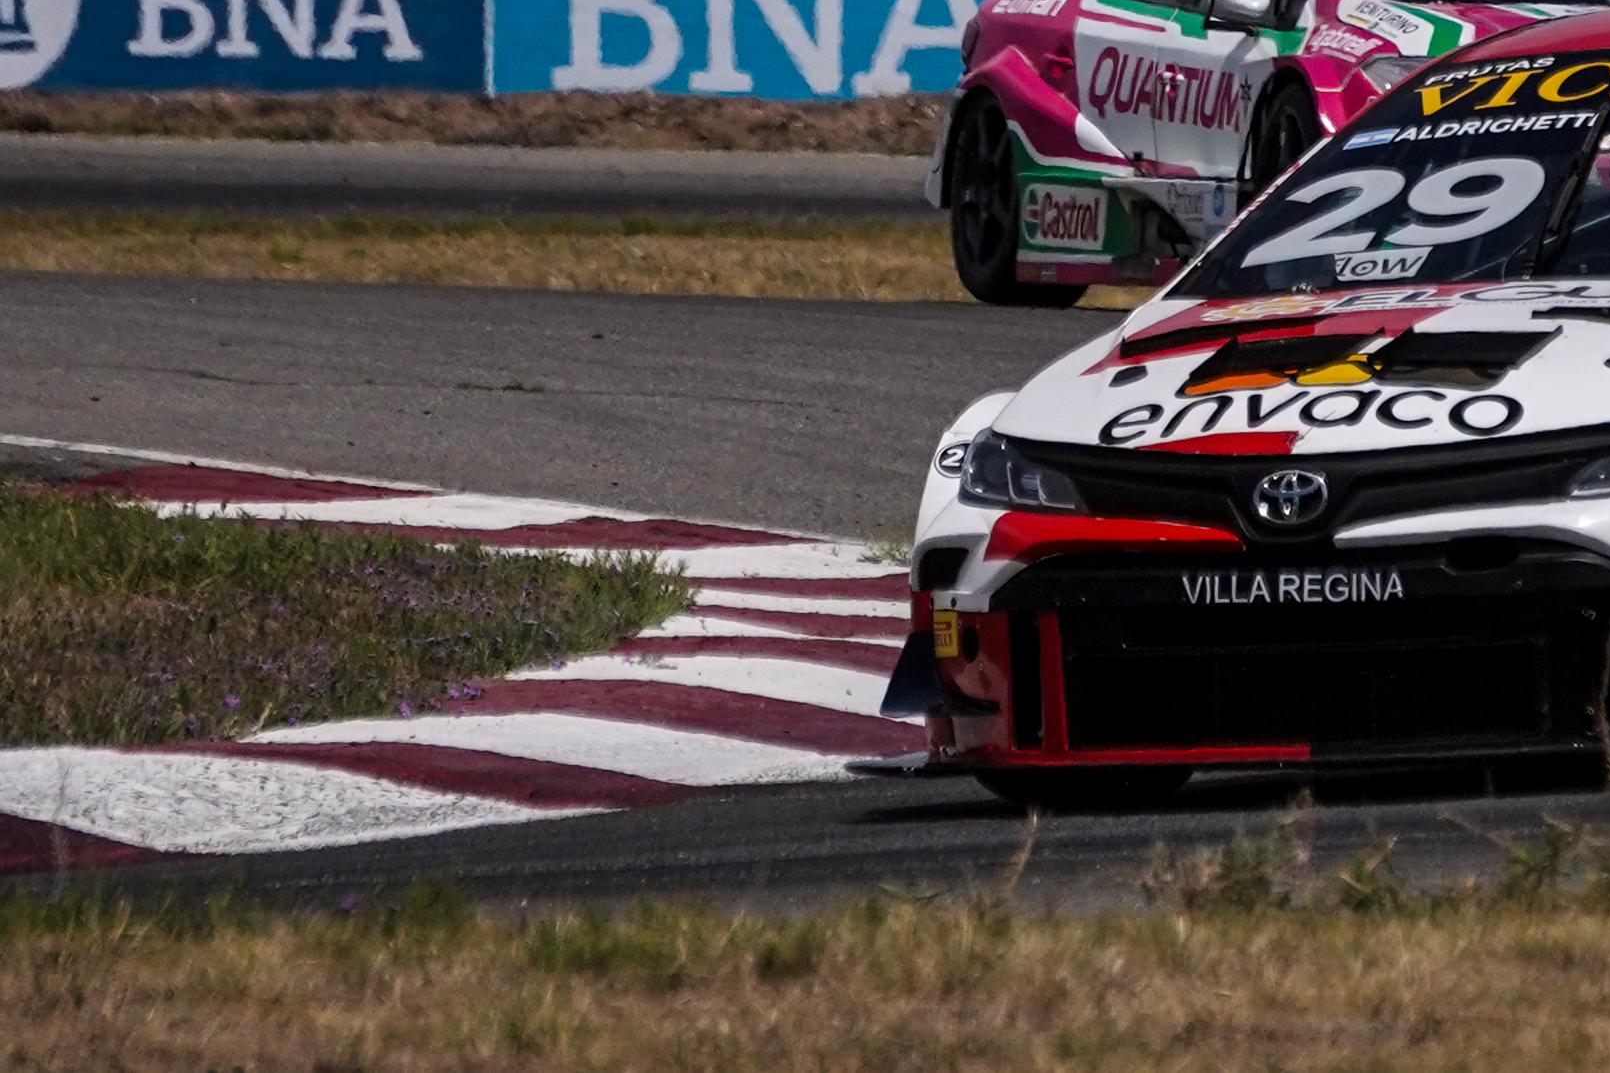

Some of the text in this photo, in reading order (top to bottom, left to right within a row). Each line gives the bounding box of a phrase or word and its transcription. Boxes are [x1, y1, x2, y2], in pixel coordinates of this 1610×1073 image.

[1424, 57, 1556, 86] FRUTAS
[1038, 191, 1098, 242] Castrol
[1241, 157, 1546, 268] 29
[1097, 389, 1526, 446] envaco
[1182, 572, 1403, 606] VILLA REGINA
